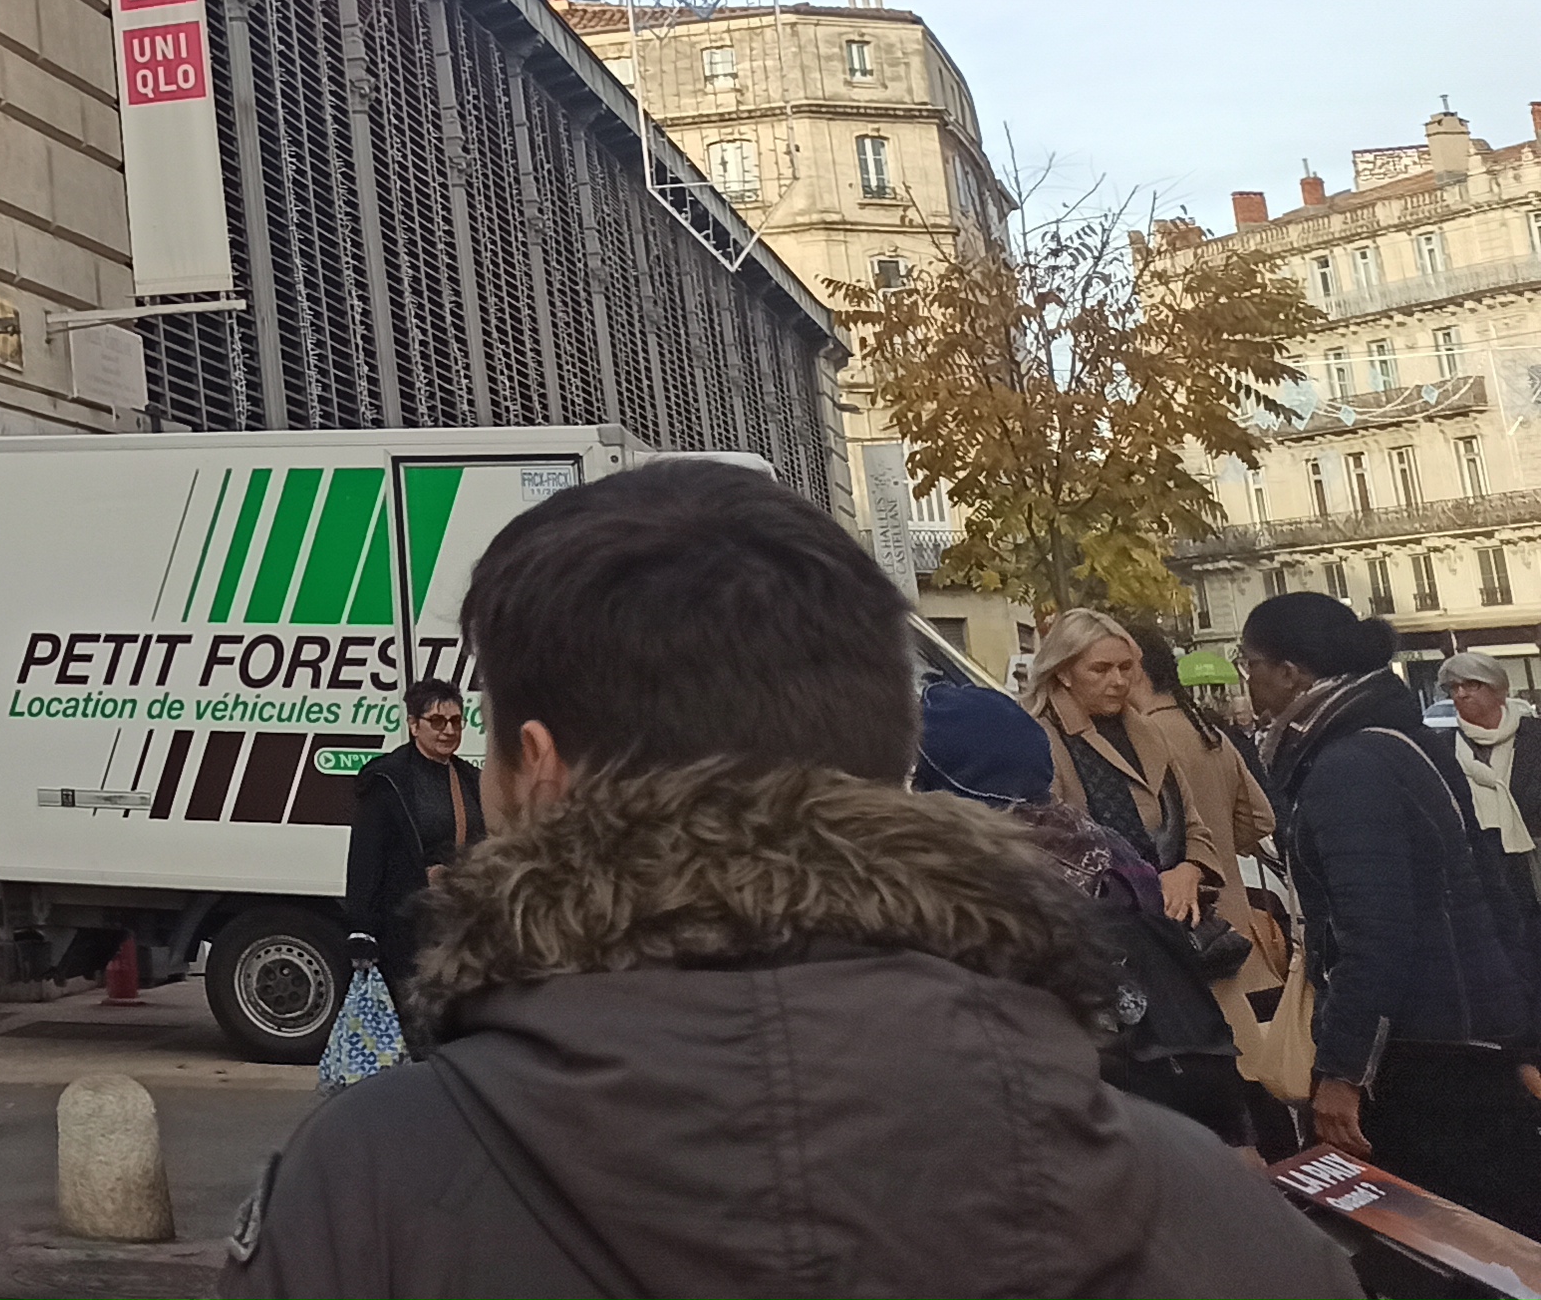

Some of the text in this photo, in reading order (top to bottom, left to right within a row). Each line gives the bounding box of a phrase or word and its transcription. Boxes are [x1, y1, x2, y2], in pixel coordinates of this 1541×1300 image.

[132, 32, 188, 63] UNI
[135, 63, 196, 99] QLO
[16, 632, 194, 687] PETIT
[8, 688, 138, 720] Location
[146, 691, 185, 720] de
[194, 692, 342, 725] véhicules
[1277, 1151, 1368, 1195] LA PAIX
[1324, 1184, 1380, 1212] Quand
